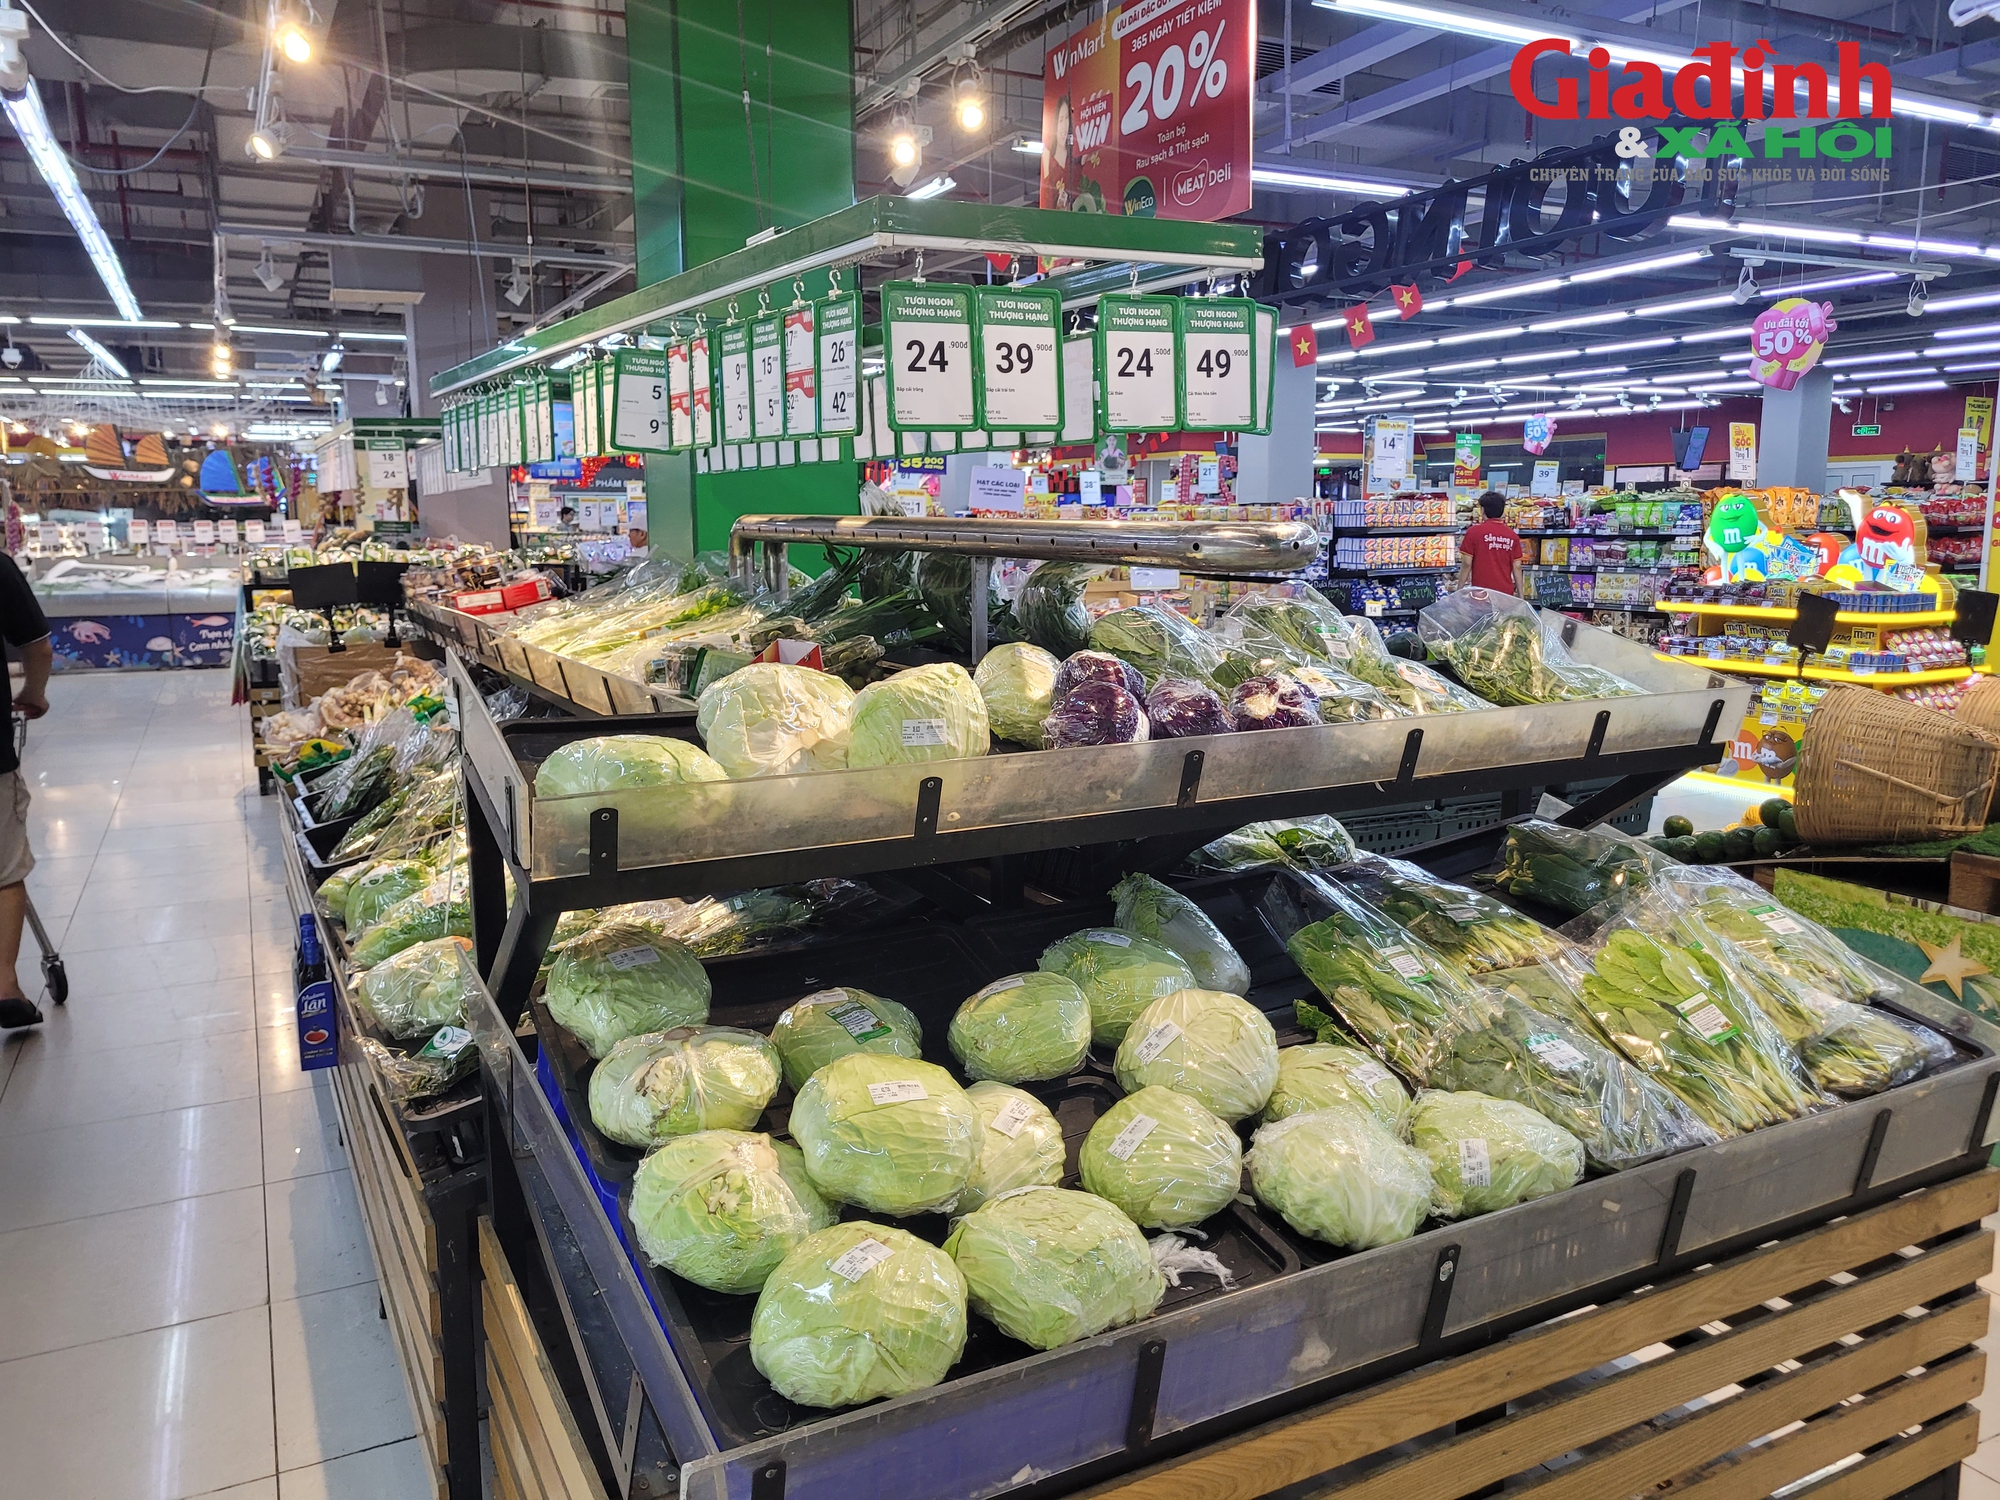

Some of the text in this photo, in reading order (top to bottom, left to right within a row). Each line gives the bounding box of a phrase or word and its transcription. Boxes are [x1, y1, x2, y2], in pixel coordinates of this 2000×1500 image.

[1131, 33, 1148, 53] 365
[1149, 19, 1174, 44] NGÀY
[1176, 4, 1196, 29] TIẾT
[1121, 18, 1227, 136] 20%
[1080, 105, 1092, 120] HỘI
[1157, 122, 1186, 144] Toàn bộ
[1136, 132, 1210, 170] Rau sạch & Thịt sạch
[1177, 162, 1232, 197] MEAT Deli
[1124, 196, 1154, 217] WinEco
[904, 296, 954, 307] TƯƠI NGON
[996, 300, 1042, 311] TƯƠI NGON
[896, 307, 962, 319] THƯỢNG HẠNG
[989, 310, 1049, 323] THƯỢNG HẠNG
[1118, 307, 1161, 316] TƯƠI NGON
[1196, 310, 1238, 319] TƯƠI NGON
[1112, 317, 1168, 328] THƯỢNG HẠNG
[1190, 320, 1245, 330] THƯỢNG HẠNG
[1764, 318, 1810, 330] Ưu đãi tới
[1758, 328, 1813, 356] 50%
[831, 340, 845, 364] 26
[906, 340, 949, 373] 24
[996, 342, 1034, 374] 39
[762, 356, 772, 376] 15
[1117, 347, 1154, 378] 24
[1196, 349, 1231, 379] 49
[655, 368, 666, 376] HẠ
[736, 363, 741, 381] 9
[652, 385, 662, 400] 5
[768, 398, 774, 417] 5
[832, 390, 847, 414] 42
[737, 404, 743, 422] 3
[650, 419, 659, 434] 9
[1527, 424, 1548, 439] 50%
[1382, 436, 1396, 450] 14
[382, 453, 395, 462] 18
[383, 470, 396, 479] 24
[1202, 468, 1212, 476] 21
[1538, 470, 1550, 478] 39
[584, 506, 592, 517] 5
[915, 502, 921, 513] 1
[1724, 528, 1742, 545] m
[1732, 741, 1754, 760] m
